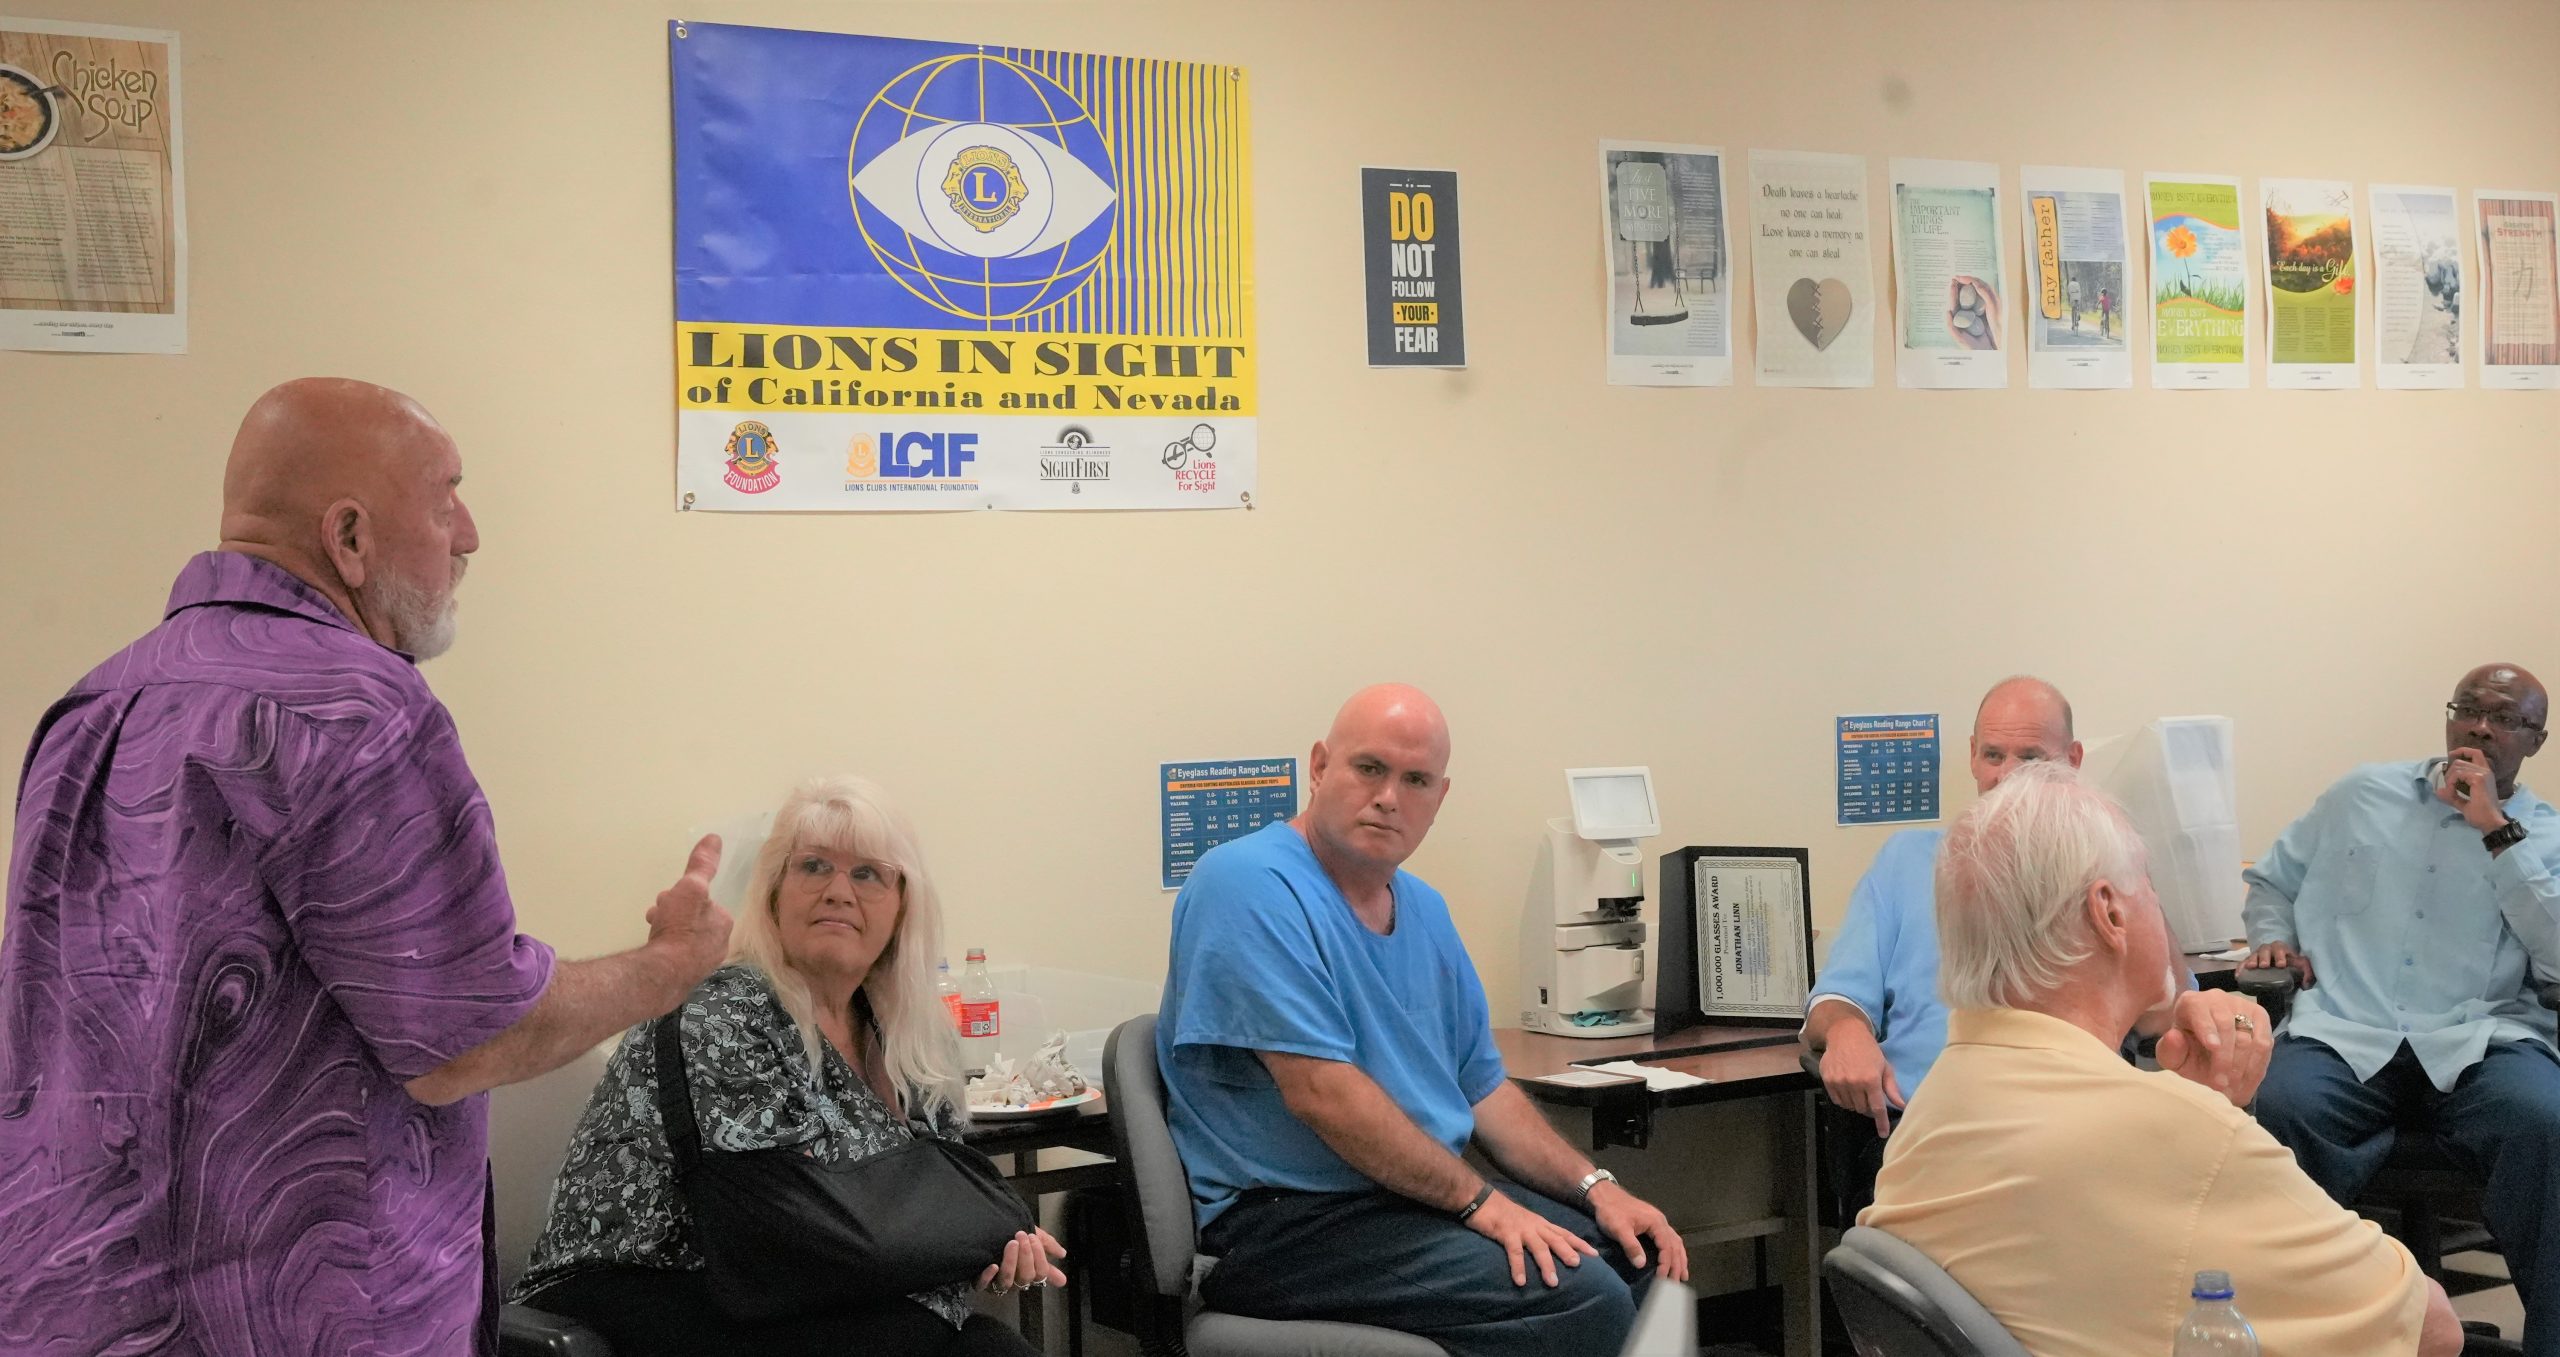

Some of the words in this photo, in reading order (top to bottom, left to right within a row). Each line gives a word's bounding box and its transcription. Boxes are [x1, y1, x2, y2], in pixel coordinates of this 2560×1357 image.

[52, 50, 157, 117] Chicken
[84, 94, 153, 143] Soup
[972, 172, 998, 203] L
[1629, 187, 1657, 201] FIVE
[1762, 184, 1787, 198] Death
[1790, 187, 1814, 199] leaves
[1817, 191, 1822, 199] a
[1825, 188, 1858, 201] heartache
[1390, 191, 1434, 241] DO
[1624, 205, 1665, 219] MORE
[1781, 209, 1790, 218] no
[1794, 209, 1807, 218] one
[1810, 210, 1823, 219] can
[1910, 204, 1961, 216] IMPORTANT
[1625, 222, 1664, 233] MINUTES
[1911, 214, 1943, 225] THINGS
[1761, 223, 1784, 237] Love
[1787, 226, 1811, 238] leaves
[1814, 230, 1819, 238] a
[1823, 230, 1852, 241] memory
[1855, 231, 1864, 240] no
[1911, 224, 1921, 234] IN
[2040, 204, 2054, 269] father
[2497, 228, 2543, 237] STRENGTH
[1391, 243, 1436, 278] NOT
[1788, 248, 1803, 257] one
[1805, 249, 1818, 258] can
[1822, 248, 1840, 258] steal
[2277, 260, 2297, 272] Each
[2298, 262, 2311, 275] day
[2312, 264, 2319, 272] is
[1391, 280, 1435, 297] FOLLOW
[2047, 277, 2058, 306] my
[2157, 319, 2244, 337] EVERYTHING
[1394, 326, 1439, 353] FEAR
[687, 331, 918, 373] LIONS
[936, 339, 1016, 374] IN
[1034, 341, 1245, 378] SIGHT
[687, 376, 733, 404] of
[748, 377, 984, 408] California
[998, 384, 1078, 410] and
[1093, 384, 1241, 411] Nevada
[738, 423, 767, 436] LIONS
[744, 437, 759, 458] L
[880, 431, 978, 478] LCIF
[1193, 459, 1216, 470] Lions
[725, 471, 778, 493] FOUNDATION
[1175, 470, 1216, 480] RECYCLE
[889, 484, 938, 492] INTERNATIONAL
[1178, 481, 1192, 491] For
[1194, 481, 1216, 493] Sight
[1849, 720, 1873, 731] Eyeglass
[1873, 720, 1894, 729] Reading
[1895, 720, 1912, 729] Range
[1912, 719, 1926, 728] Chart
[1177, 768, 1208, 779] Eyeglass
[1209, 766, 1237, 777] Reading
[1238, 765, 1260, 776] Range
[1261, 764, 1280, 774] Chart
[1711, 875, 1720, 910] AWARD
[1733, 902, 1741, 923] LINN
[1712, 912, 1722, 954] GLASSES
[1733, 924, 1743, 975] JONATHAN
[1715, 955, 1724, 1000] 1,000,000
